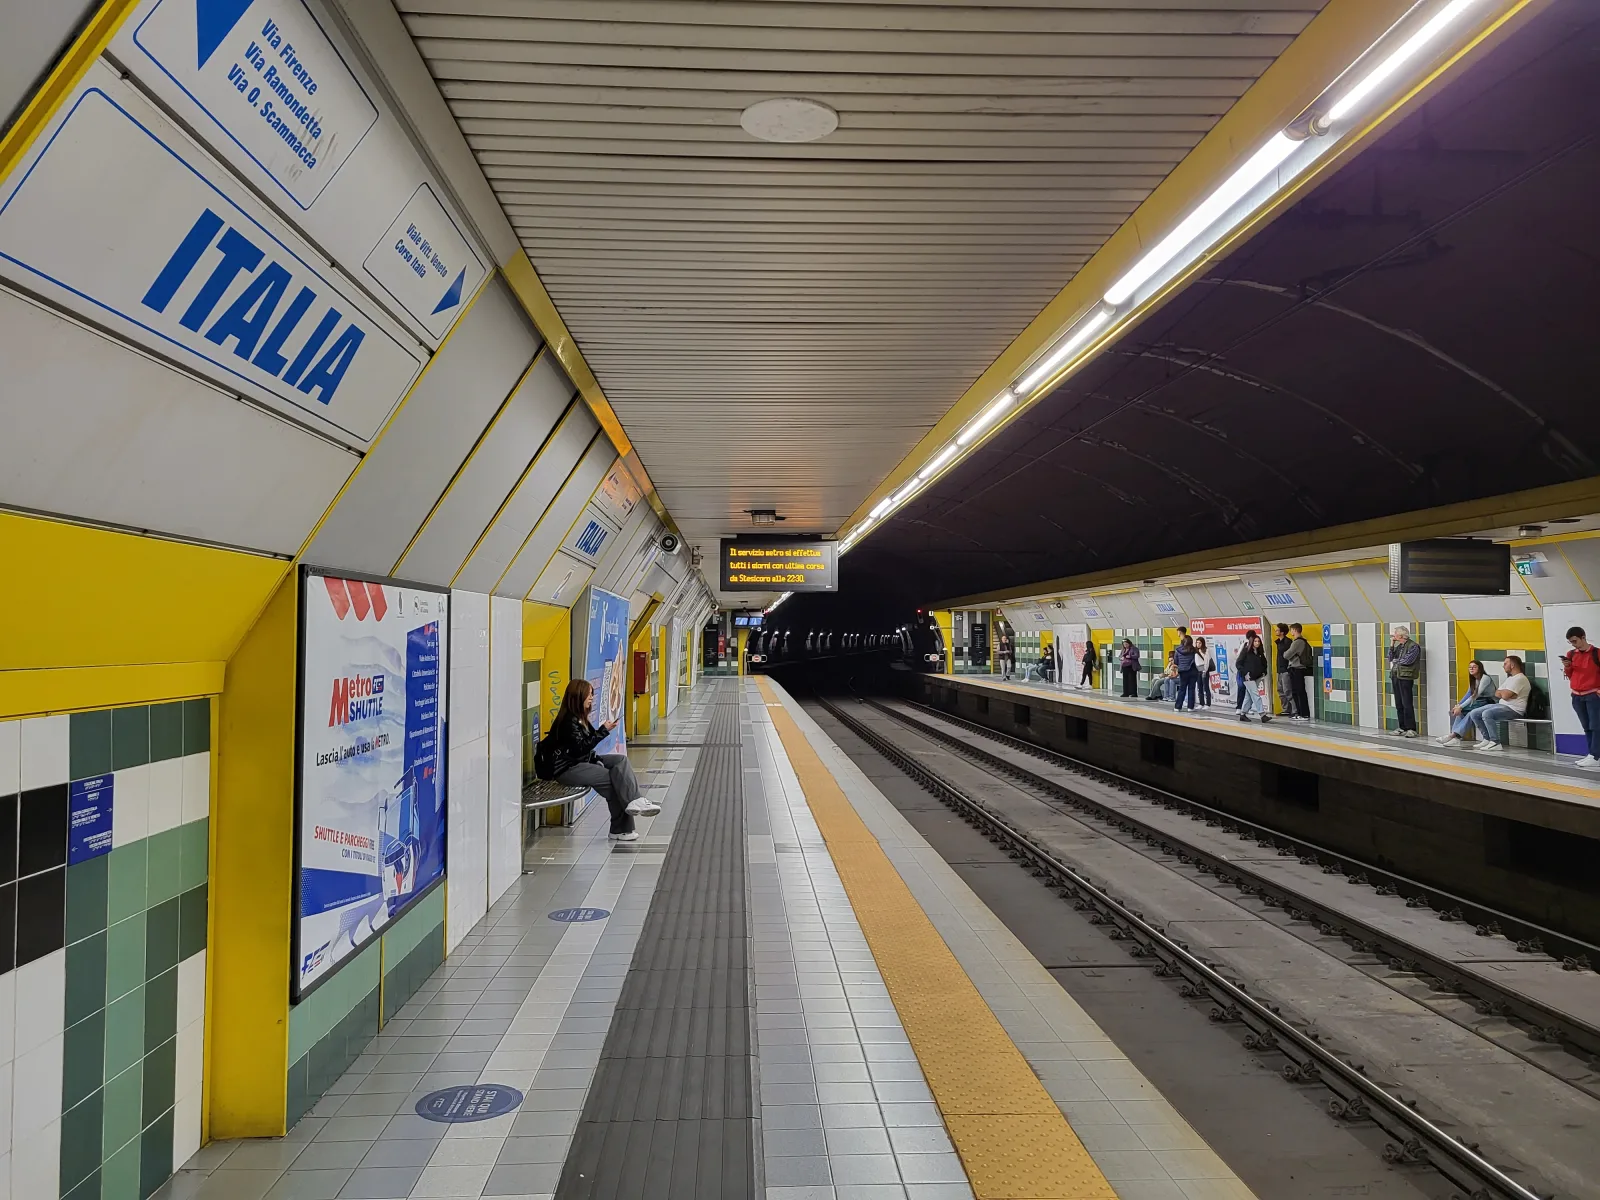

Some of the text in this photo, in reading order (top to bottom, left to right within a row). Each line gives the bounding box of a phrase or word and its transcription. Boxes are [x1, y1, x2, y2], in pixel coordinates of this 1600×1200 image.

[262, 18, 317, 96] Via Firenze
[245, 41, 322, 139] Via Ramondetta
[227, 63, 317, 169] Via O. Scammacca
[395, 238, 426, 279] Corso Italia
[406, 222, 448, 278] Viale Vitt. Veneto
[141, 208, 366, 405] ITALIA
[575, 520, 608, 557] ITALIA
[729, 547, 737, 556] Il
[737, 548, 765, 557] servizio
[785, 549, 792, 557] si
[792, 549, 821, 557] effettua
[729, 561, 747, 570] tutti
[784, 562, 805, 570] ultima
[729, 574, 738, 582] da
[739, 574, 771, 582] Stesicoro
[1264, 593, 1295, 606] ITALIA
[328, 673, 372, 727] Metro
[349, 696, 383, 722] SHUTTLE
[316, 747, 339, 767] Lascia
[356, 746, 360, 755] e
[360, 742, 371, 754] usa
[314, 825, 339, 844] SHUTTLE
[339, 831, 345, 845] E
[344, 832, 370, 849] PARCHEGGI
[462, 1089, 486, 1117] STAND HERE
[476, 1090, 498, 1114] STAI QUI
